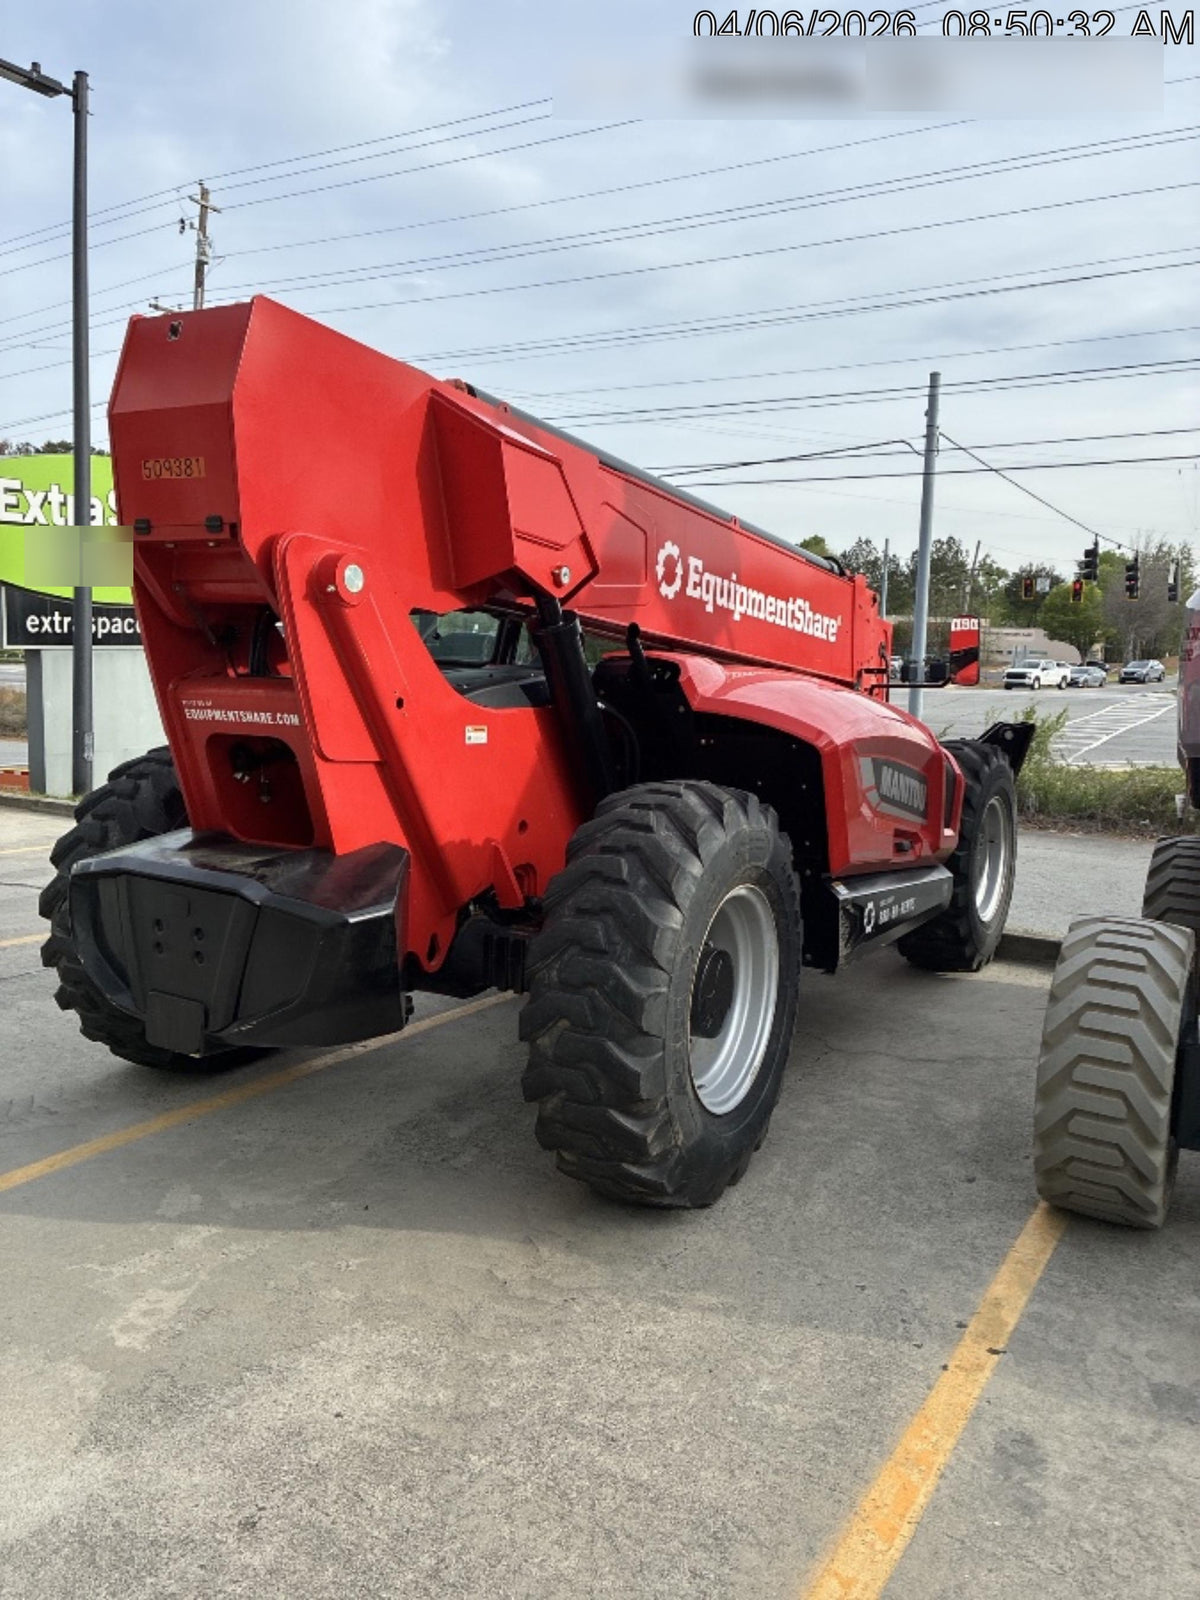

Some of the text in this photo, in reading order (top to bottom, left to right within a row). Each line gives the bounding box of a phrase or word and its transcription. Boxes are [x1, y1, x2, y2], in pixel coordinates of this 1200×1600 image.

[143, 458, 201, 479] 509381
[685, 555, 839, 643] EquipmentShare
[184, 708, 300, 726] EQUIPMENTSHARE.COM
